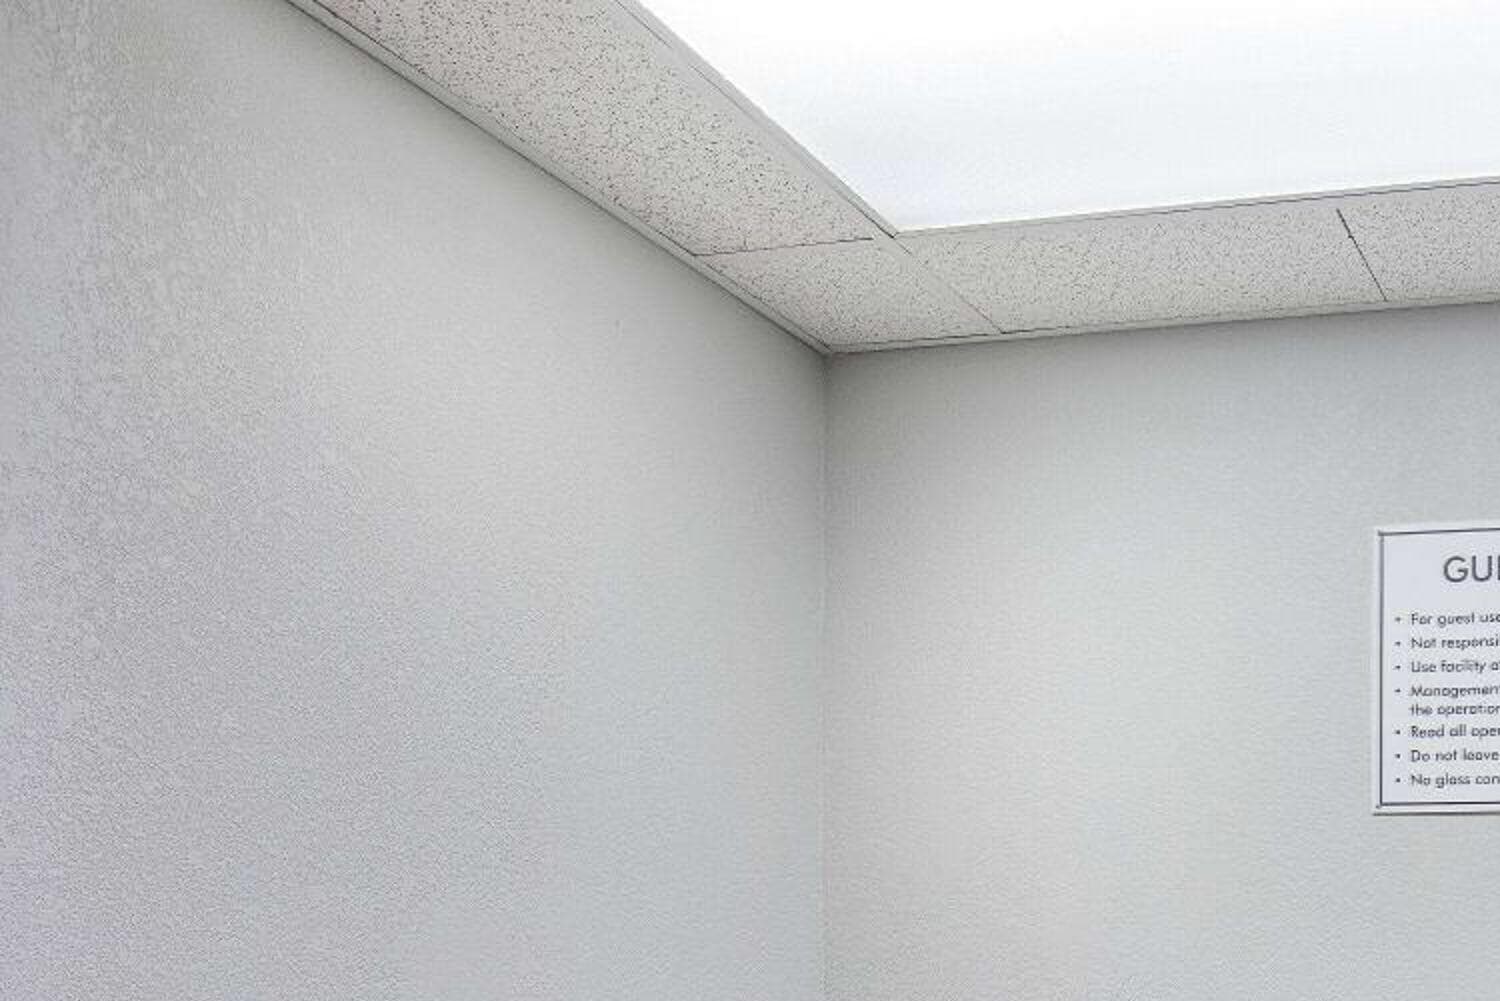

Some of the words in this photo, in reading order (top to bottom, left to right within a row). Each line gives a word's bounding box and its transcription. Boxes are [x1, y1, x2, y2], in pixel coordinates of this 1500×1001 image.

[1410, 612, 1432, 625] For
[1437, 612, 1475, 628] guest
[1410, 638, 1437, 650] Not
[1411, 661, 1437, 673] Use
[1441, 659, 1485, 674] facility
[1410, 703, 1433, 716] the
[1410, 724, 1445, 738] Read
[1449, 723, 1467, 737] all
[1410, 749, 1431, 762] Do
[1435, 749, 1457, 761] not
[1463, 748, 1499, 761] leave
[1410, 774, 1431, 786] No
[1436, 773, 1470, 789] glass
